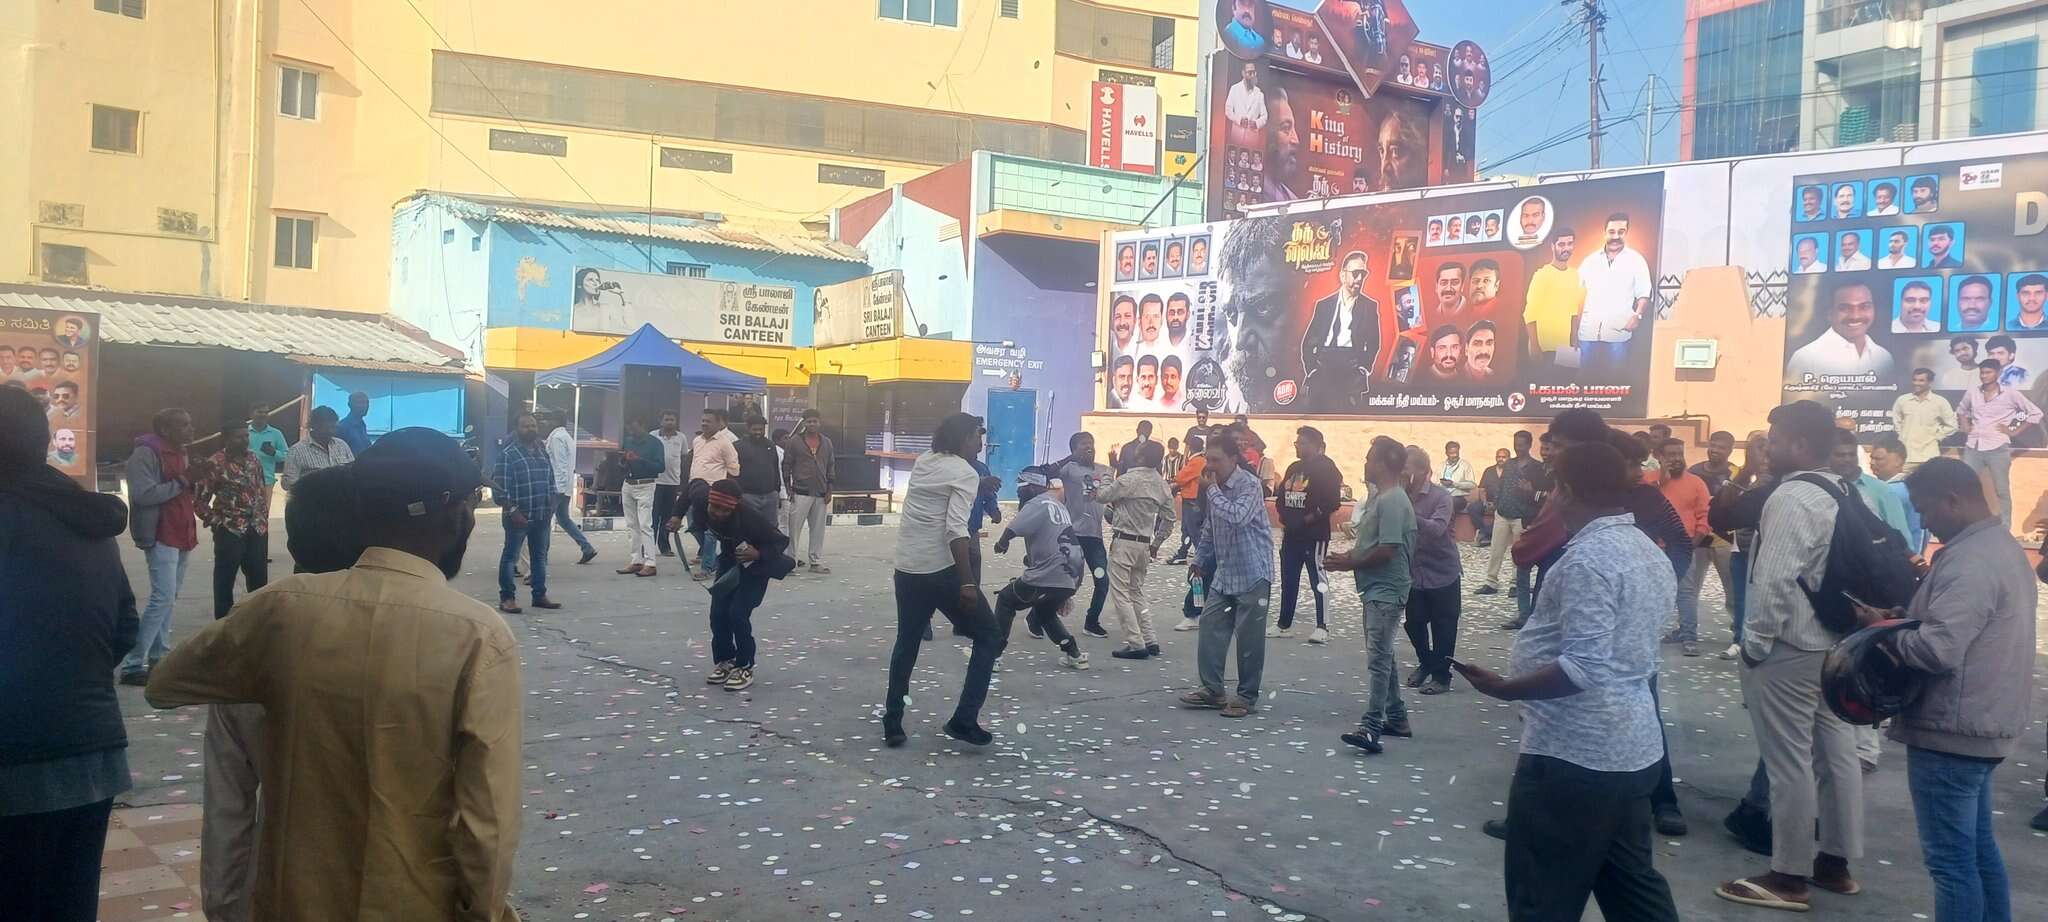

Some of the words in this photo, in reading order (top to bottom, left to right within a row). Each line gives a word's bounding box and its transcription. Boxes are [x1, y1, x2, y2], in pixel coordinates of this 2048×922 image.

[1310, 110, 1344, 136] King
[1309, 133, 1362, 163] History
[759, 288, 793, 300] பாலாஜி
[720, 313, 741, 326] SRI
[745, 316, 789, 331] BALAJI
[864, 311, 872, 323] SRI
[874, 307, 892, 321] BALAJI
[724, 328, 784, 343] CANTEEN
[866, 323, 891, 338] CANTEEN
[976, 357, 1025, 369] EMERGENCY
[1028, 361, 1044, 369] EXIT
[1804, 373, 1816, 383] P.
[1821, 370, 1877, 383] ஜெயபால்
[1368, 394, 1395, 406] மக்கள்
